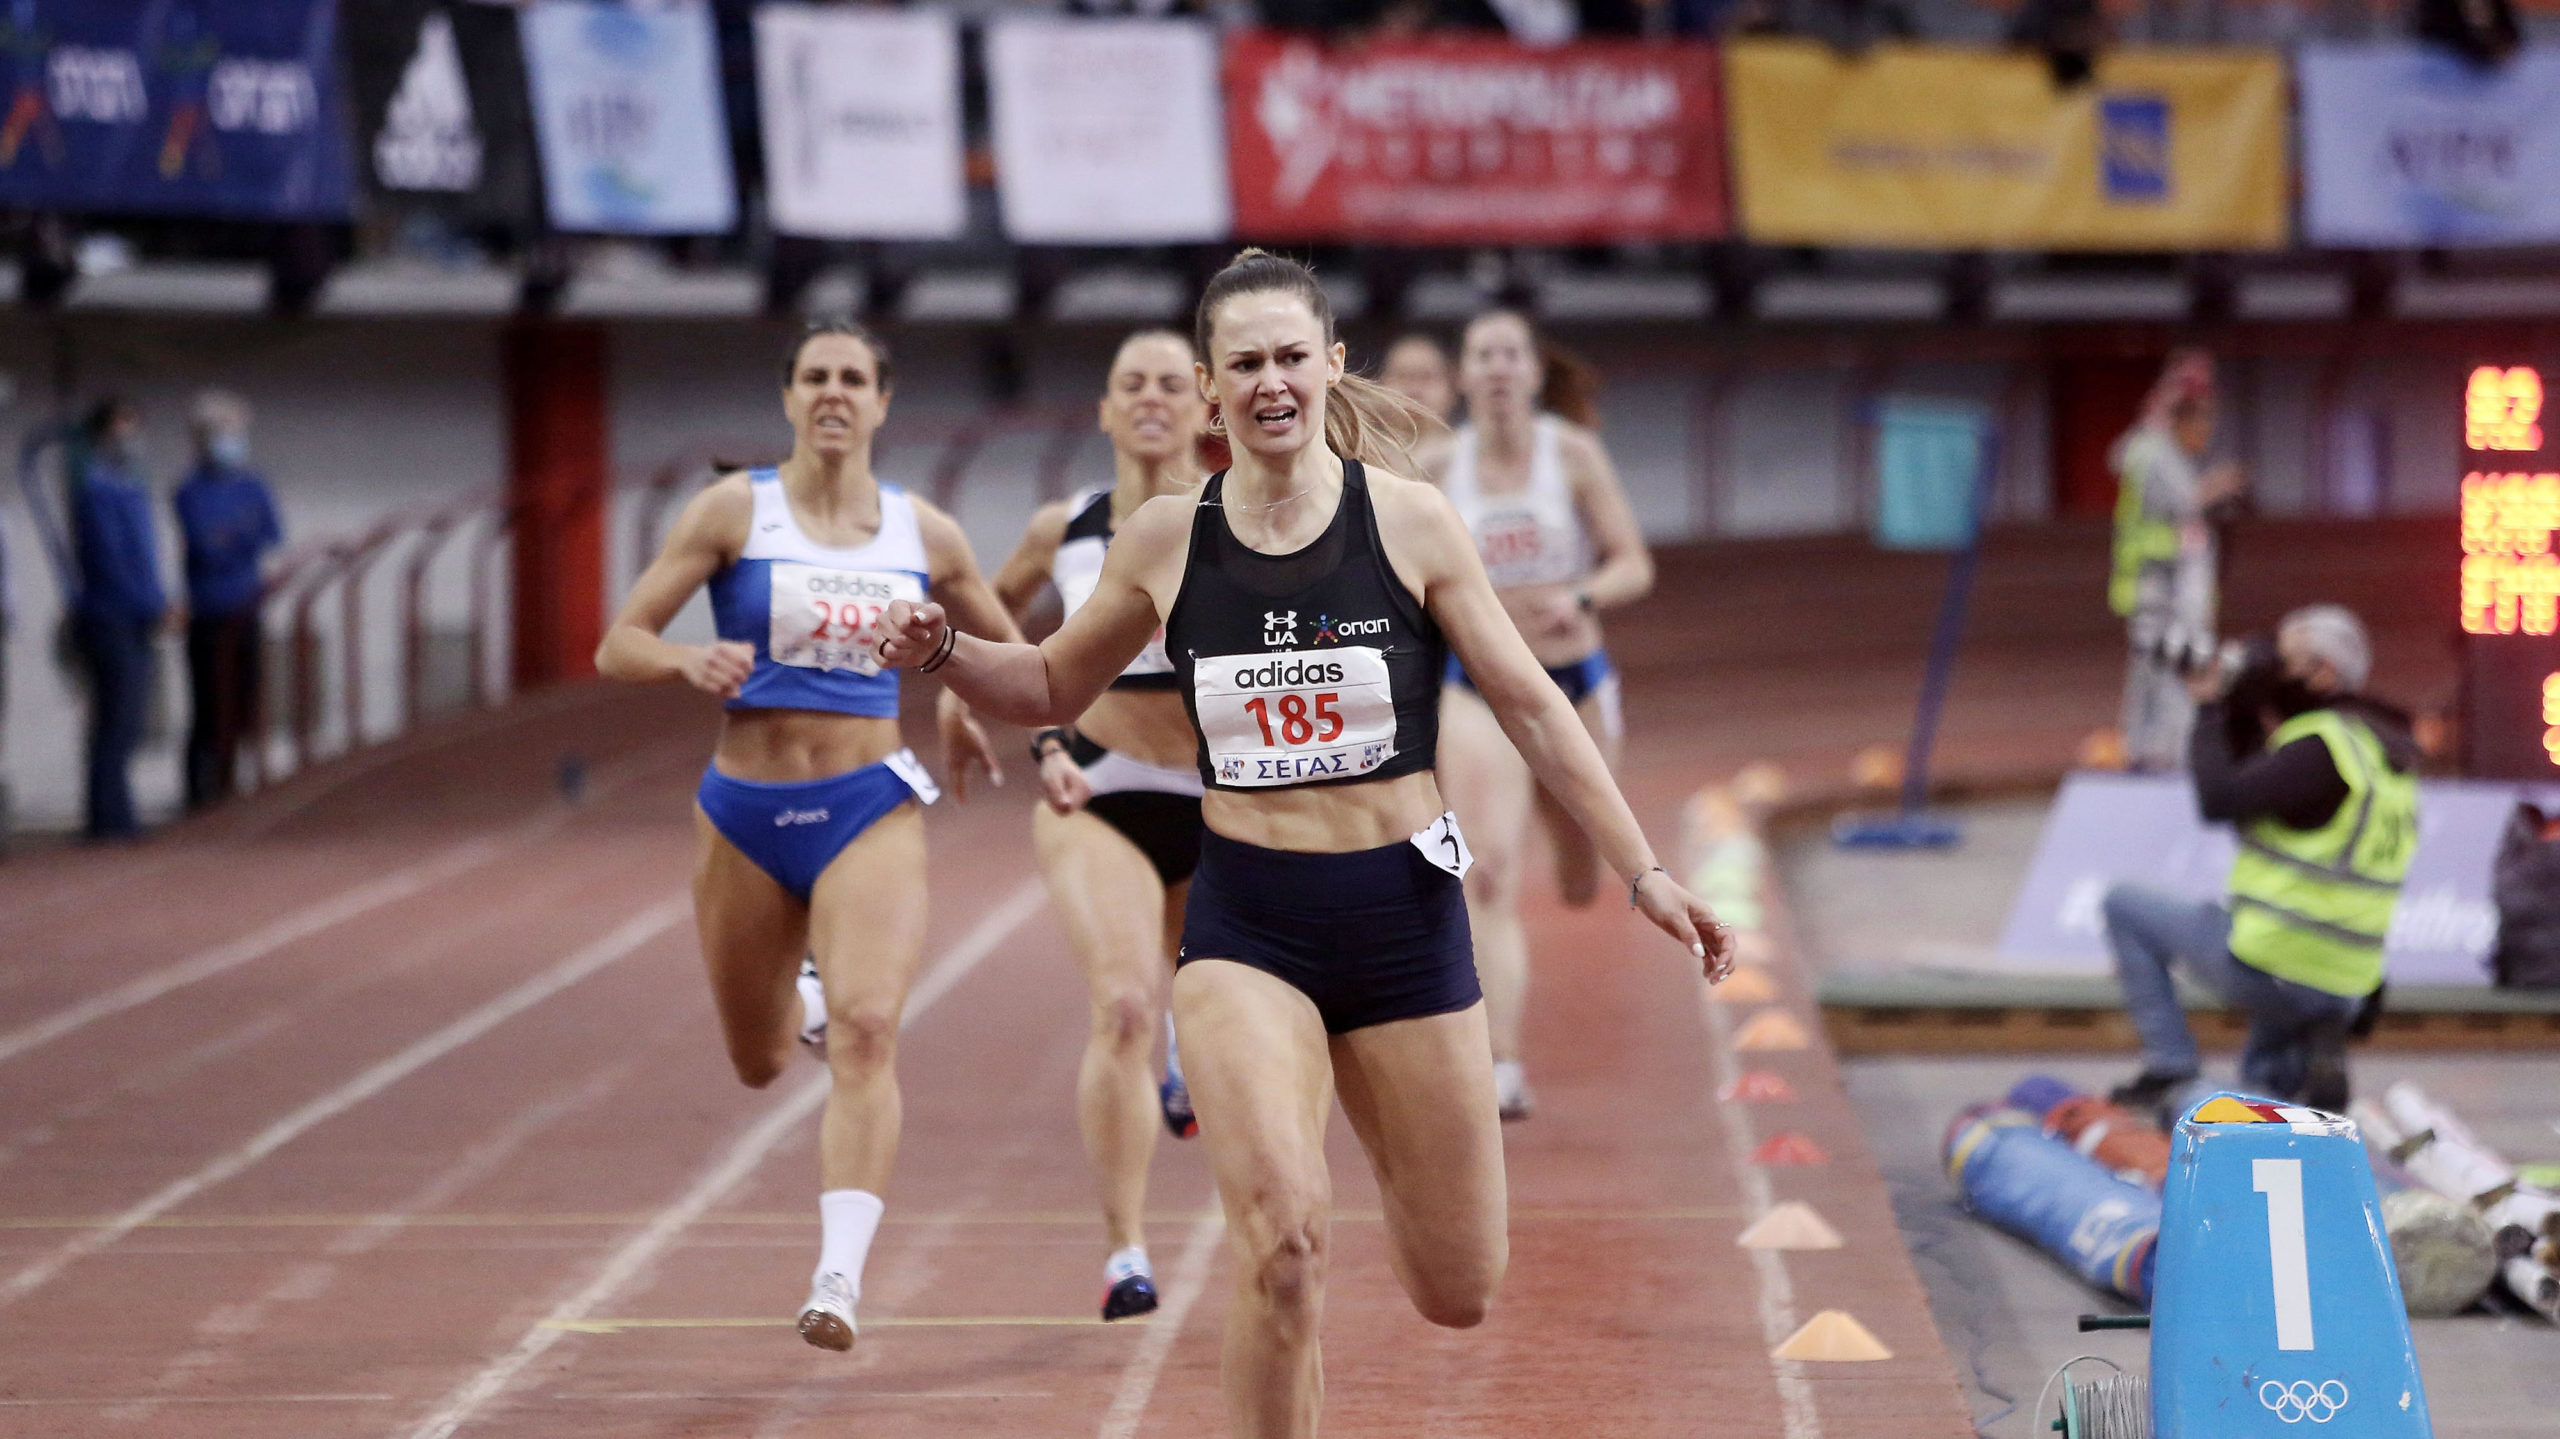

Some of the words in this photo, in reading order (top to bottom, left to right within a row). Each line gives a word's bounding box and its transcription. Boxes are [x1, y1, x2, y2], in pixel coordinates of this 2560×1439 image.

[807, 576, 892, 600] adidas
[1264, 631, 1298, 646] UA
[1235, 659, 1344, 689] adidas
[1244, 693, 1344, 747] 185
[1256, 753, 1349, 780] ΣΕΓΑΣ
[2252, 1159, 2315, 1351] 1
